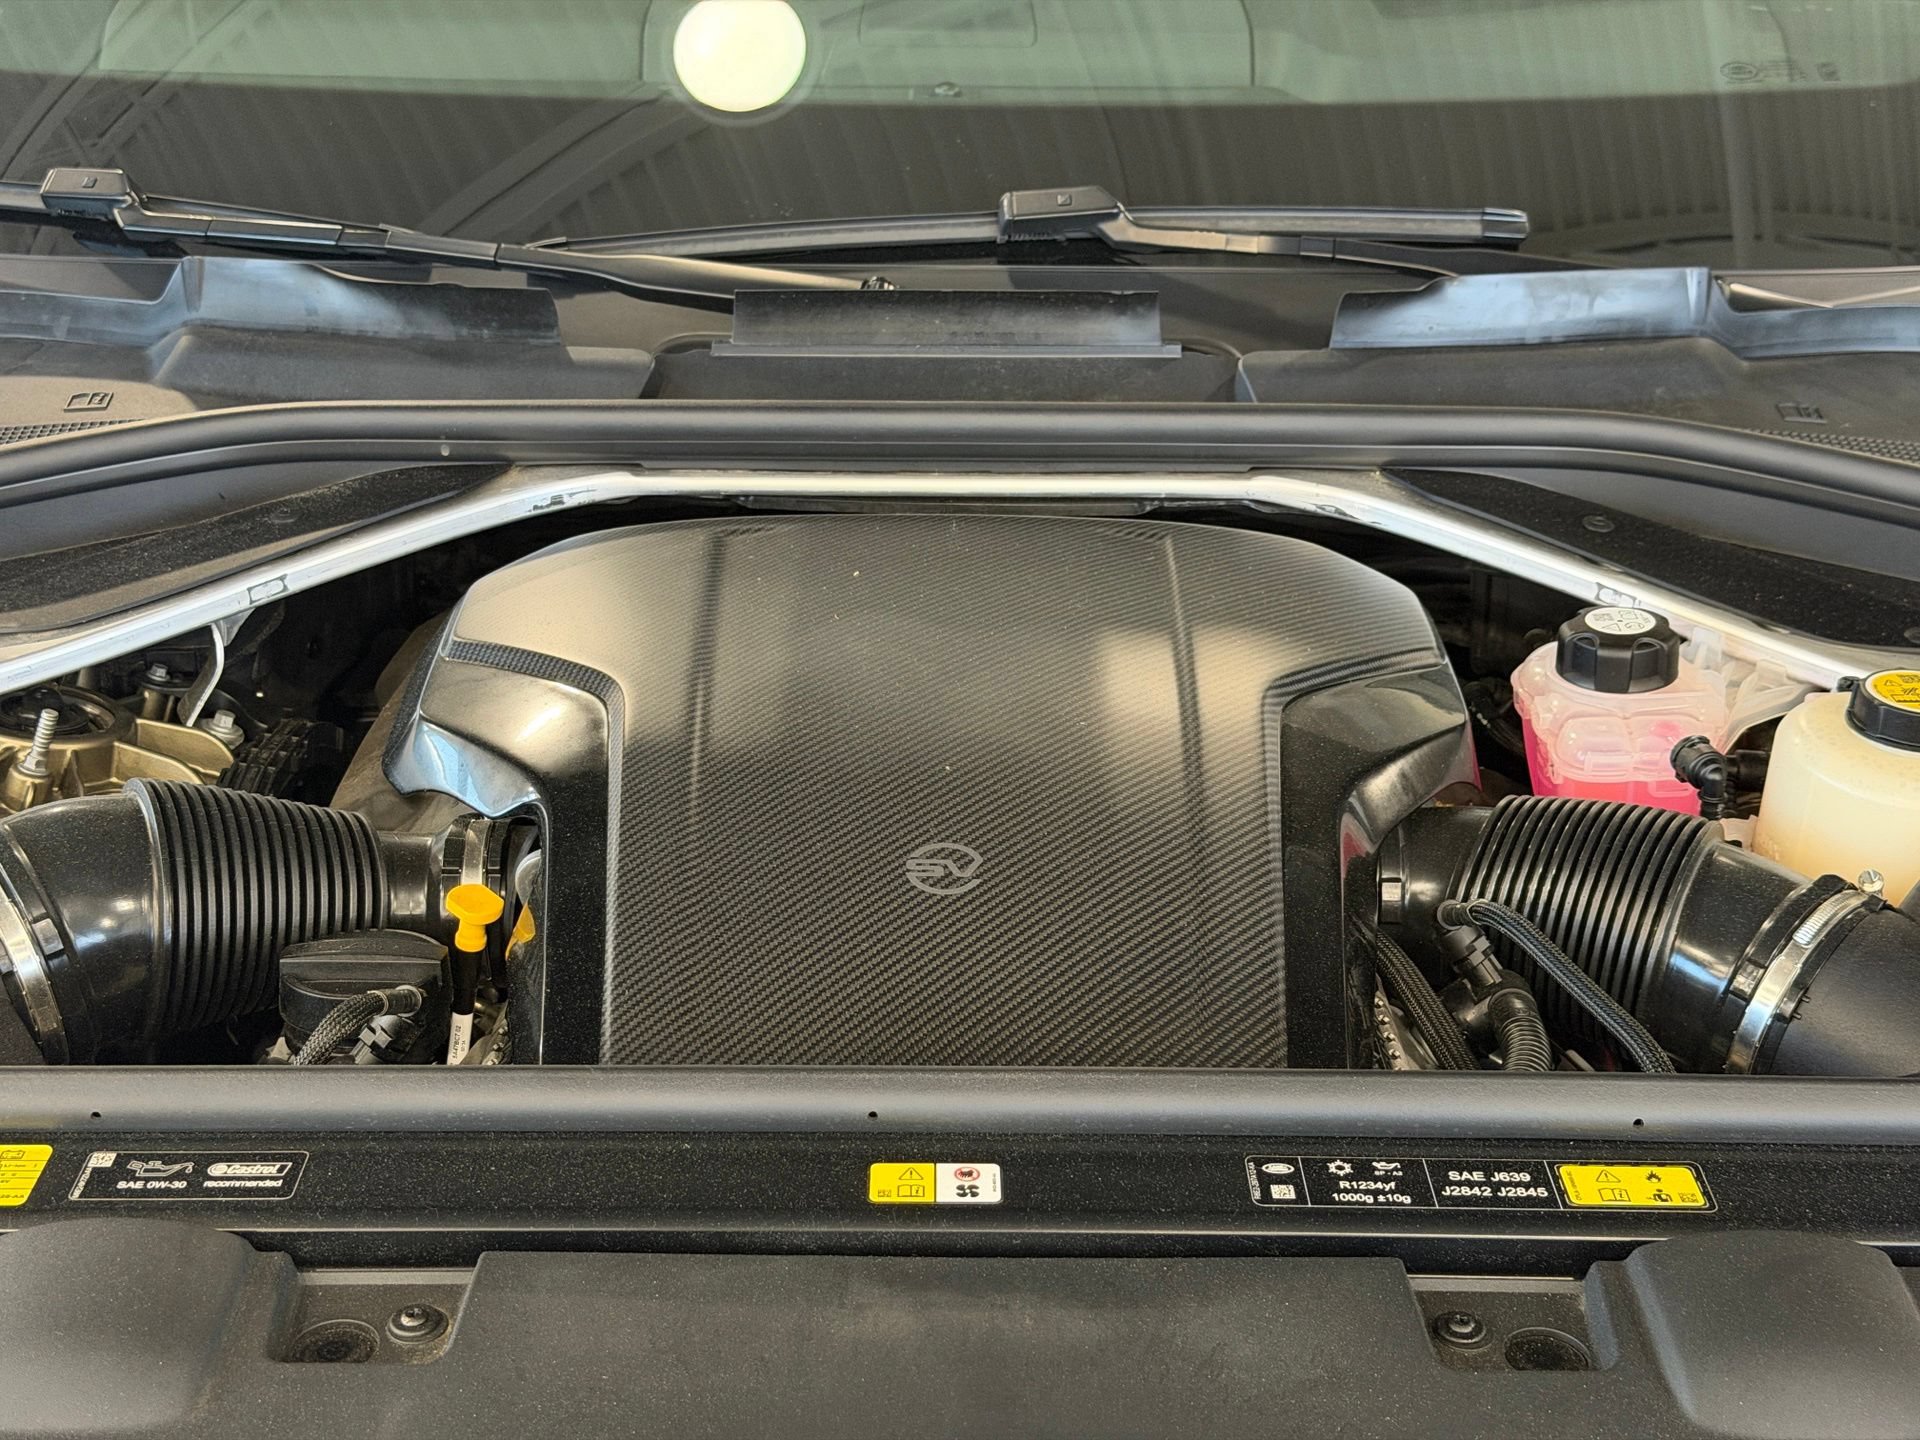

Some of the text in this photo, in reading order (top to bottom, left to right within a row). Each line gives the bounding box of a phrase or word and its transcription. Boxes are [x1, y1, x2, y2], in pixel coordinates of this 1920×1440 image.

[226, 1164, 281, 1174] Castrol
[1447, 1170, 1531, 1182] SAE J639
[116, 1180, 187, 1189] SAE 0W-30
[203, 1179, 283, 1188] recommended
[1339, 1181, 1396, 1192] R1234yf
[1441, 1185, 1549, 1197] J2842 J2845
[1331, 1193, 1412, 1204] 1000g ±10g
